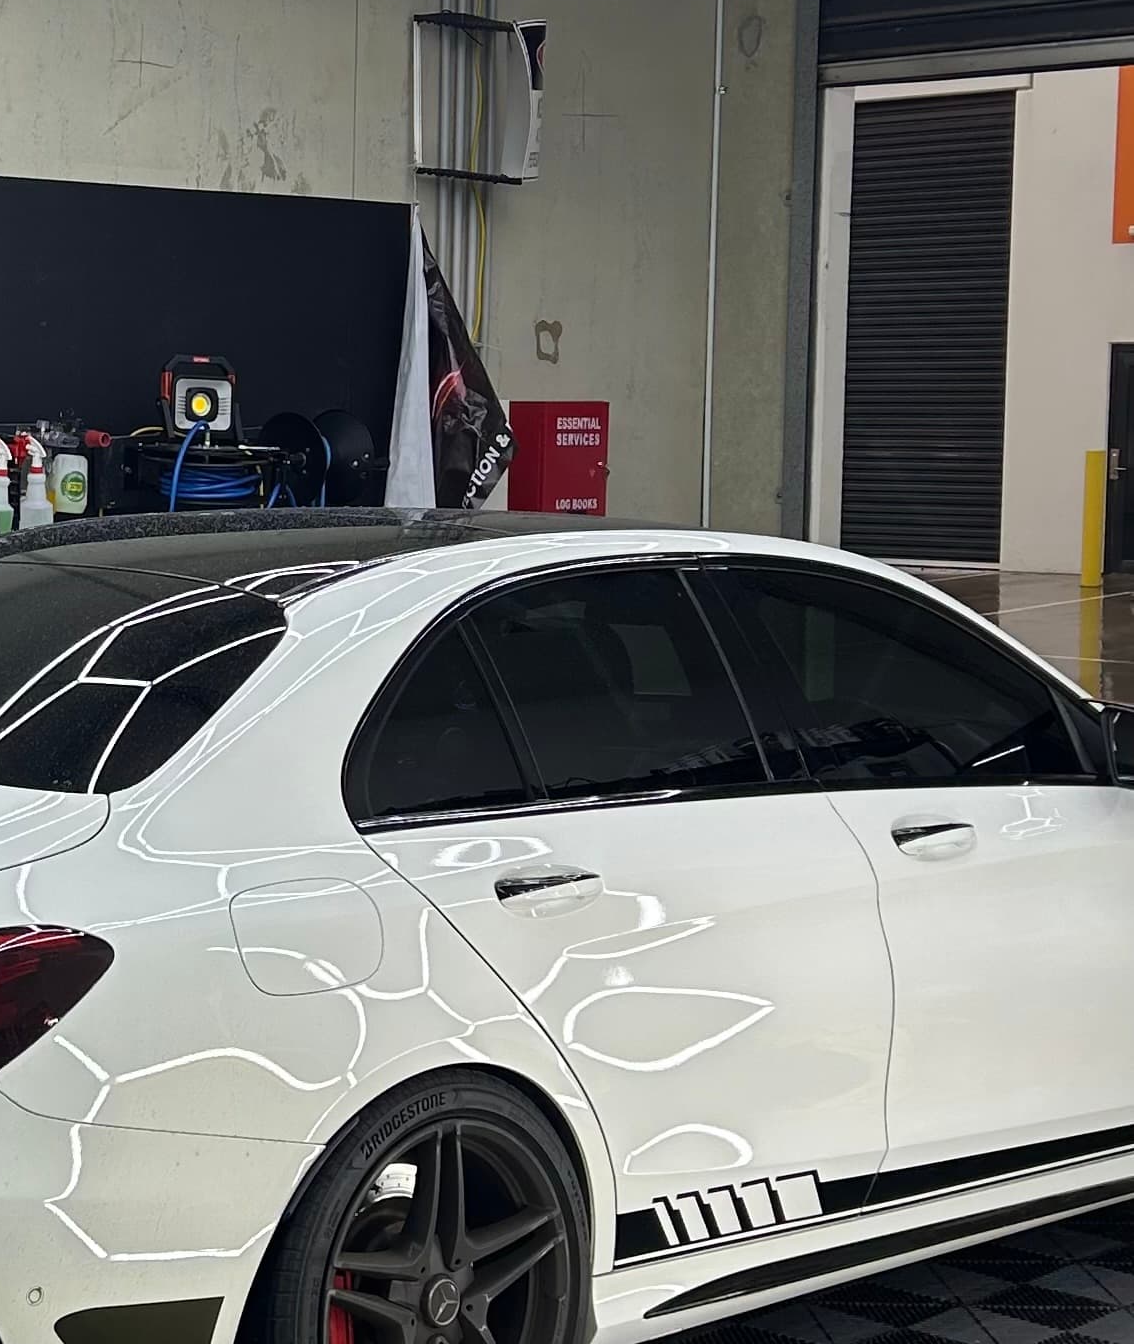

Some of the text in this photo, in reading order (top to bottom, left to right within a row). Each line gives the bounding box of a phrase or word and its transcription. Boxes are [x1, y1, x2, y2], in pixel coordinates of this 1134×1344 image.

[556, 417, 601, 430] ESSENTIAL
[495, 433, 511, 448] &
[556, 433, 600, 446] SERVICES
[556, 498, 597, 510] LOG BOOKS
[361, 1091, 446, 1161] BRIDGESTONE
